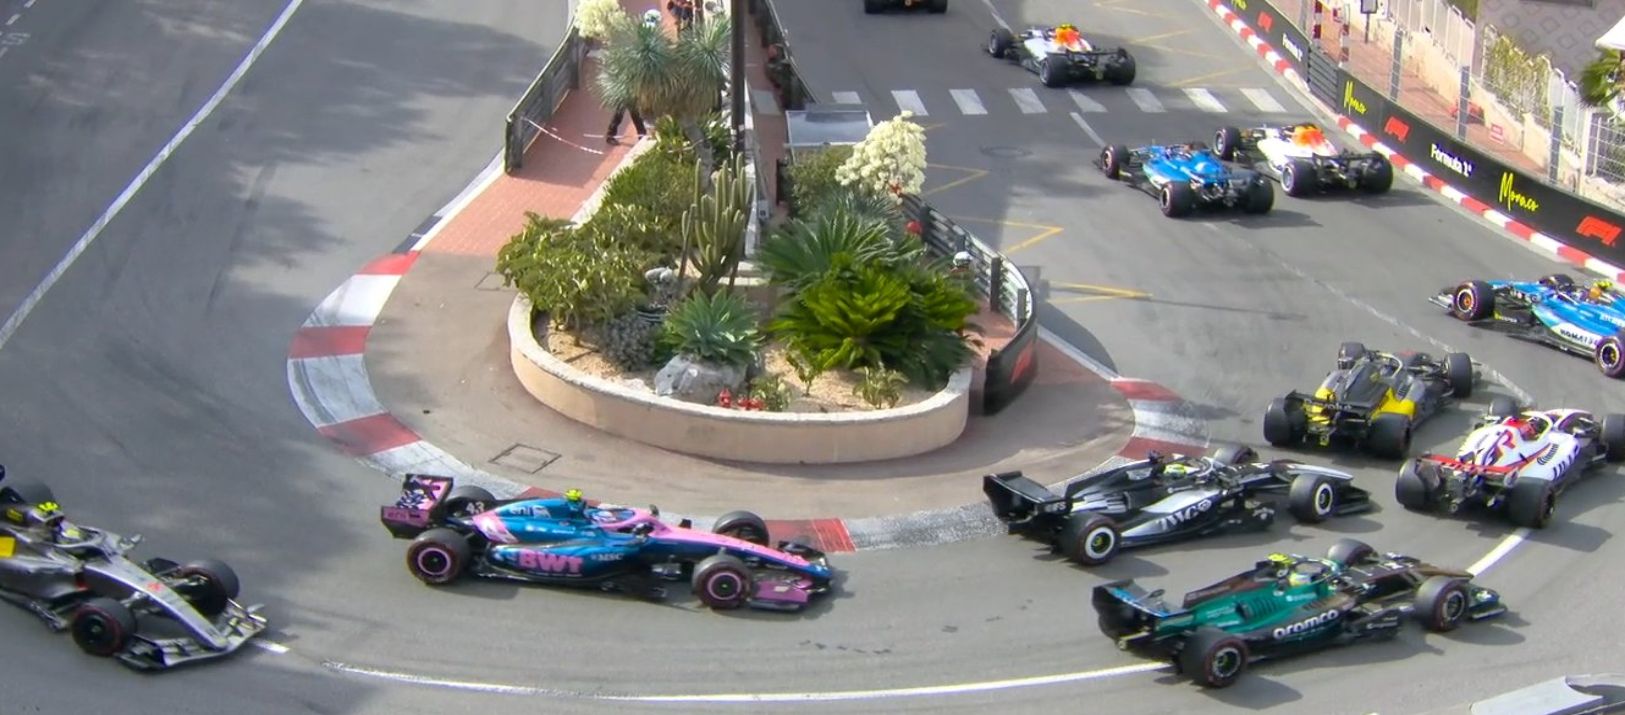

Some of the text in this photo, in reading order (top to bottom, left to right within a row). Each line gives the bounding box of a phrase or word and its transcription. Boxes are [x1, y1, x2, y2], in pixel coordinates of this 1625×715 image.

[1498, 171, 1539, 213] Monaco
[465, 502, 485, 515] 43
[519, 548, 584, 574] BWT
[1272, 608, 1339, 639] aramco
